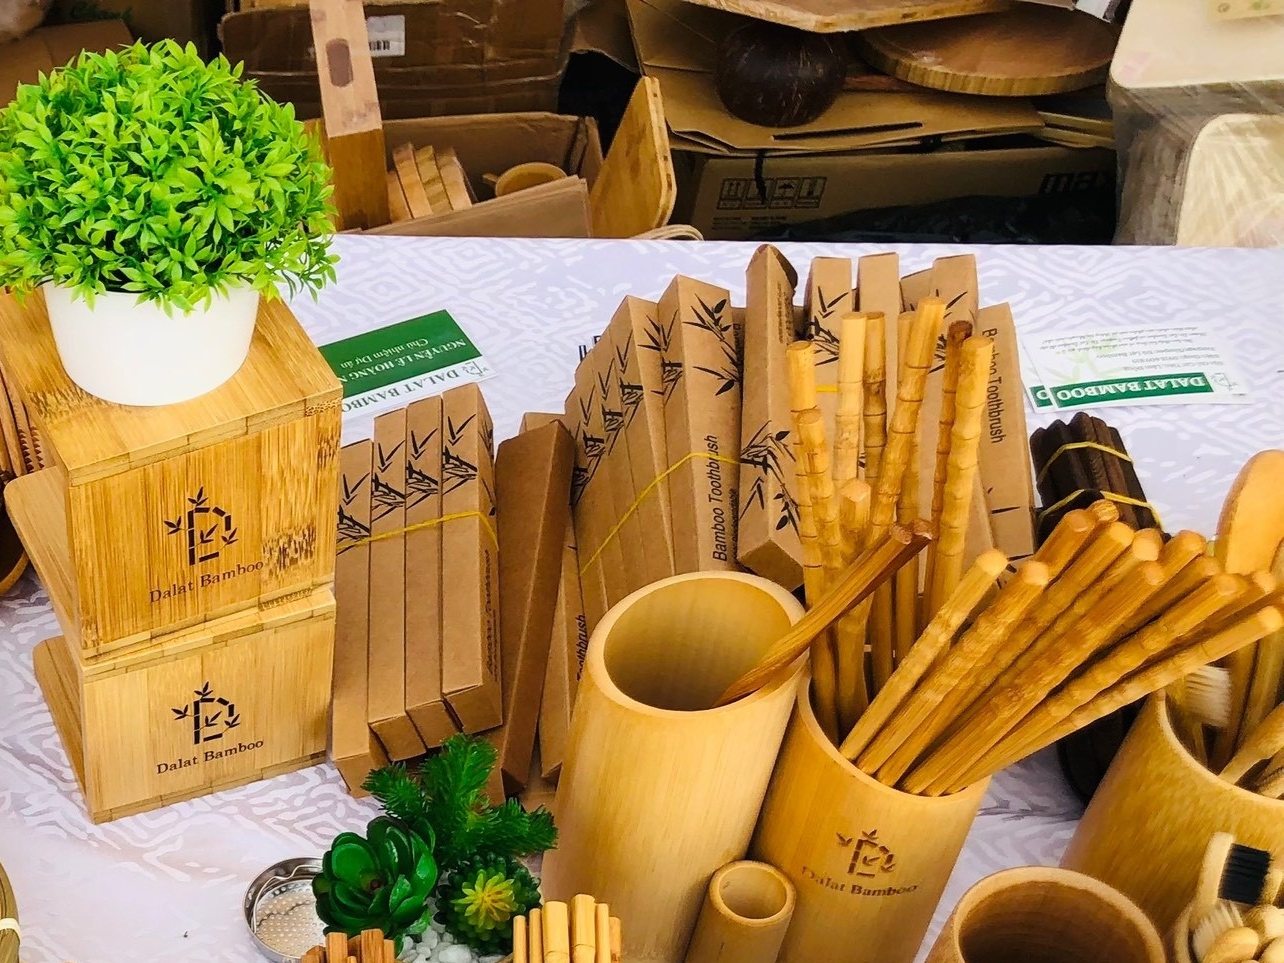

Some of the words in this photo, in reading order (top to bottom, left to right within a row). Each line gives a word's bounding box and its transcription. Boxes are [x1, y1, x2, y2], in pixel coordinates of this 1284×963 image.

[348, 359, 395, 382] HOÀNG
[402, 368, 458, 394] DALAT
[1142, 375, 1206, 390] DALAT
[1056, 379, 1140, 401] BAMBOO
[710, 507, 729, 562] Bamboo
[149, 578, 195, 604] Dalat
[199, 559, 264, 589] Bamboo
[156, 755, 199, 775] Dalat
[203, 738, 264, 763] Bamboo
[850, 884, 918, 896] Bamboo
